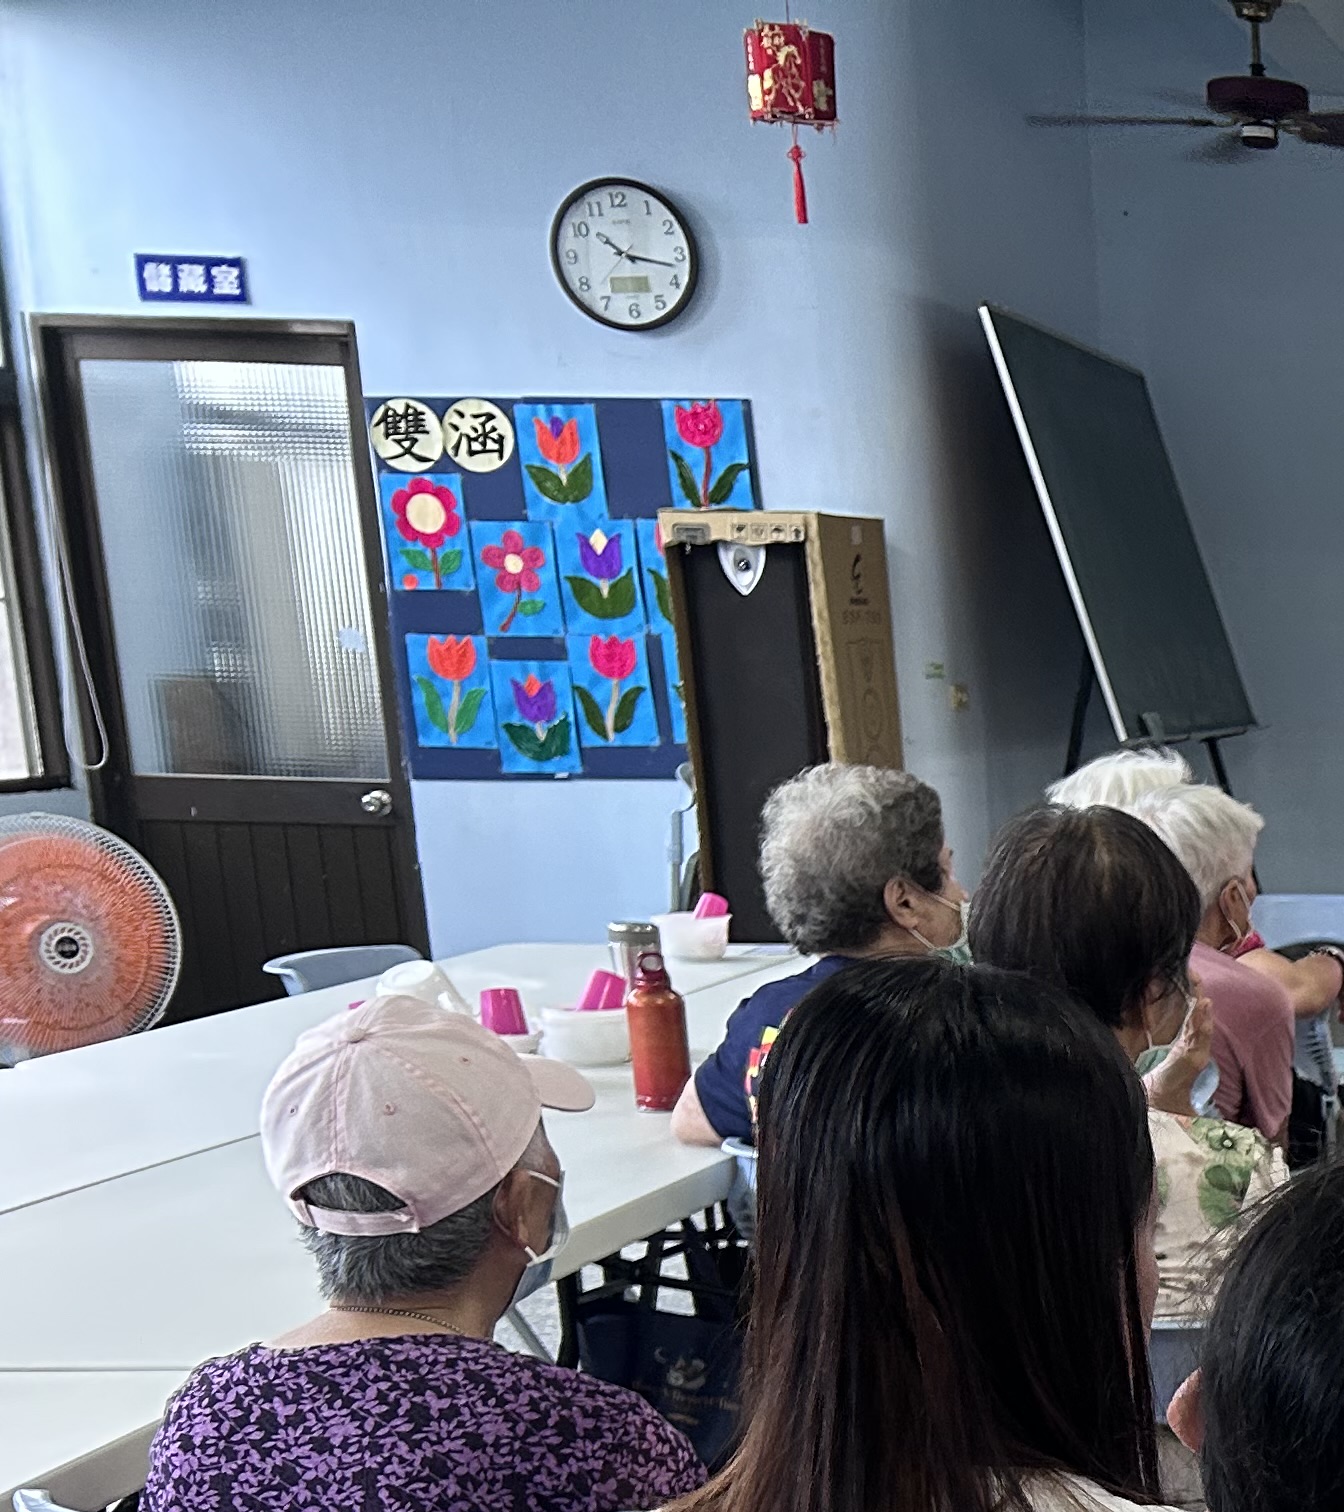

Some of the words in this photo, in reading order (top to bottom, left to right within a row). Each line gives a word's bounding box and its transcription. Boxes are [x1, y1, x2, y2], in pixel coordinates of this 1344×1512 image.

[608, 191, 628, 208] 12
[643, 200, 652, 215] 1
[587, 201, 604, 217] 11
[571, 221, 590, 238] 10
[662, 219, 675, 235] 2
[565, 249, 578, 265] 9
[673, 246, 686, 263] 3
[578, 276, 591, 292] 8
[669, 274, 681, 290] 4
[600, 295, 611, 311] 7
[628, 302, 641, 319] 6
[654, 294, 667, 311] 5
[373, 402, 505, 462] 雙涵
